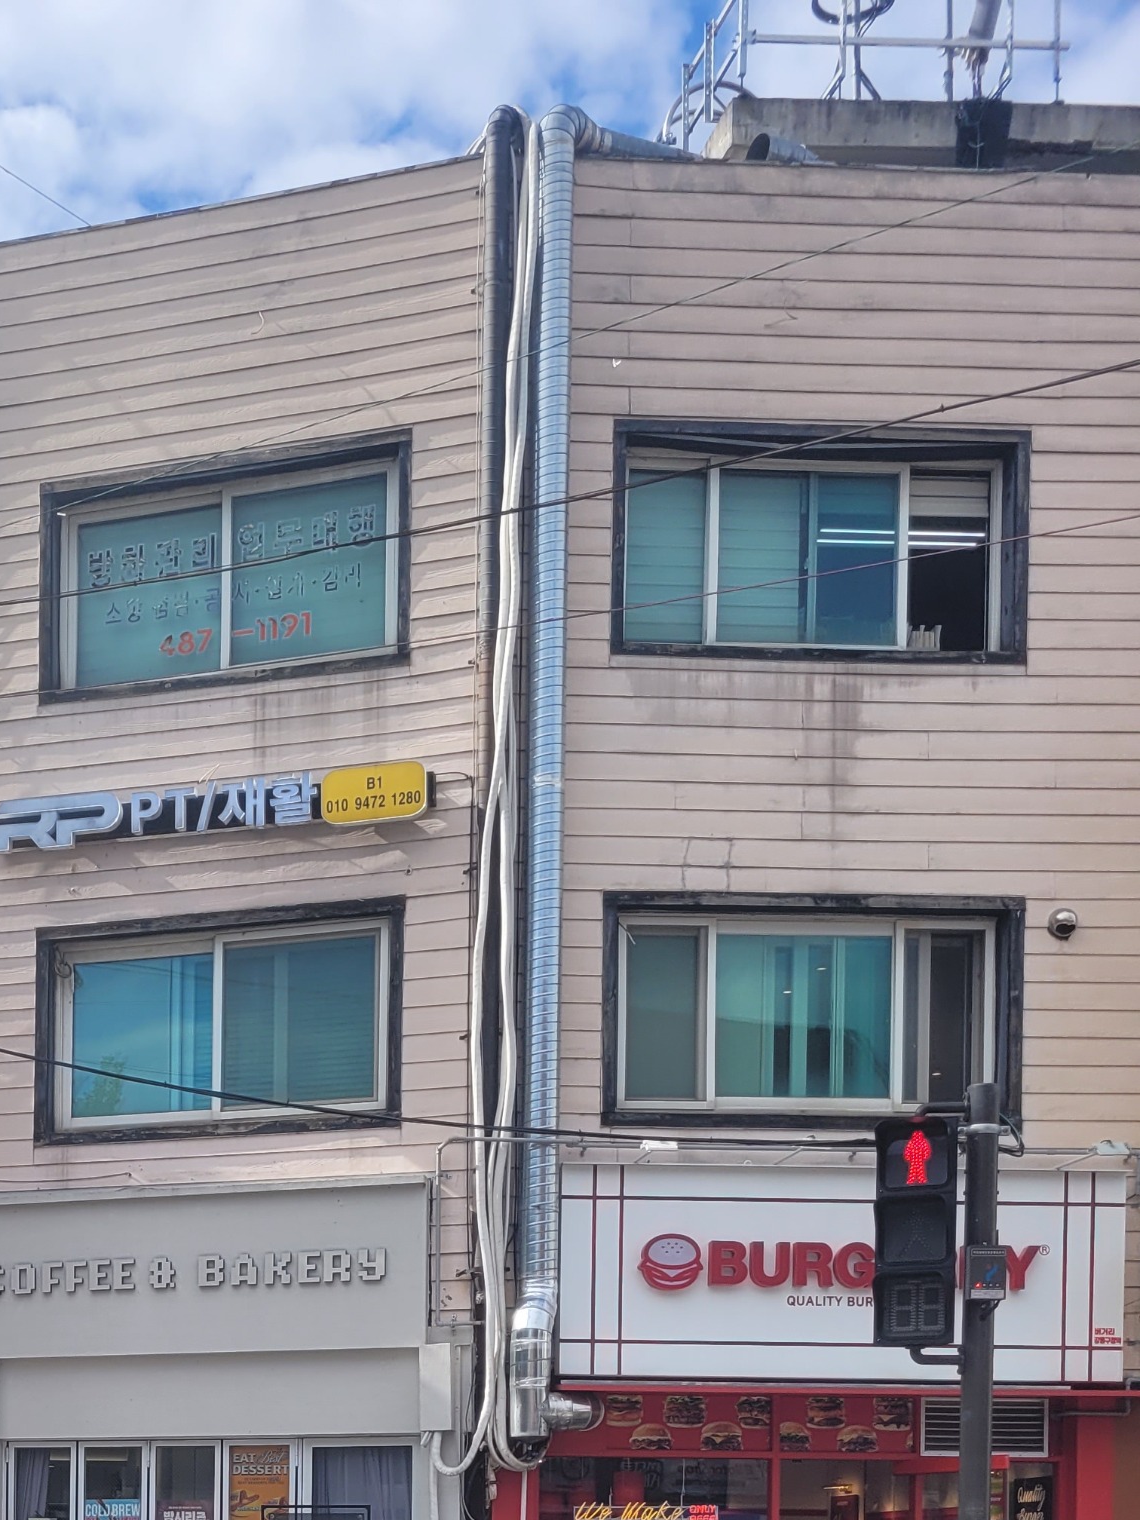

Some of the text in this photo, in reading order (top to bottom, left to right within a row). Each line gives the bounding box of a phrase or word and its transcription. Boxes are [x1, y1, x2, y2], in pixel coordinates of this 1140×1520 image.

[366, 777, 383, 790] B1
[326, 790, 422, 814] 010 9472 1280
[148, 1256, 176, 1289] &
[198, 1247, 387, 1288] BAKERY
[708, 1240, 1040, 1290] BURGY
[786, 1295, 843, 1307] QUALITY
[232, 1453, 256, 1463] EAT
[232, 1464, 289, 1476] DESSERT
[111, 1503, 140, 1517] BREW
[574, 1500, 686, 1520] We Make
[689, 1504, 717, 1514] ONLY
